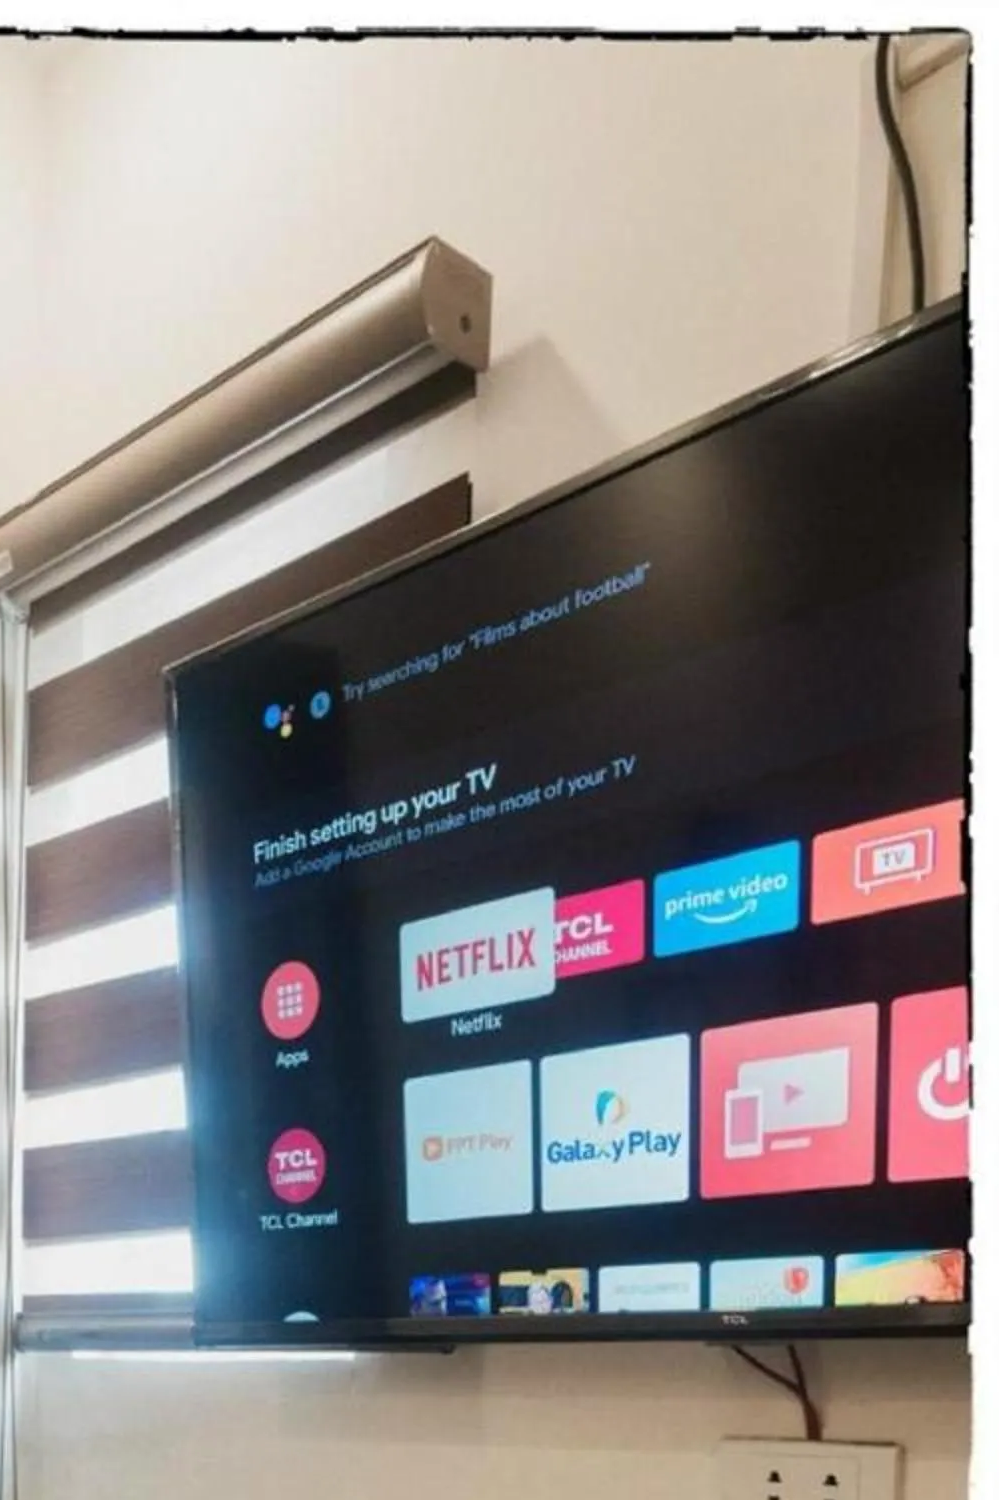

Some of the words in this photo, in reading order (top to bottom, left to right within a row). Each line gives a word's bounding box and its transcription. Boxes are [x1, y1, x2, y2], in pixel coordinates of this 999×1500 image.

[343, 682, 365, 701] Try
[367, 651, 439, 693] searching
[442, 640, 465, 662] for
[519, 597, 570, 630] about
[253, 829, 307, 864] Finish
[310, 809, 377, 846] setting
[380, 800, 408, 826] up
[411, 780, 462, 819] your
[465, 763, 497, 795] TV
[255, 869, 280, 888] Add
[282, 867, 292, 880] a
[294, 850, 342, 876] Google
[345, 831, 403, 860] Account
[406, 826, 422, 842] to
[424, 811, 466, 837] make
[469, 802, 497, 823] the
[500, 785, 542, 813] most
[543, 777, 565, 800] of
[567, 767, 609, 796] your
[612, 755, 637, 779] TV
[664, 886, 724, 920] prime
[728, 872, 788, 900] video
[555, 912, 614, 944] TCL
[416, 928, 536, 992] NETFLIX
[451, 1010, 503, 1037] Netflix
[275, 1049, 309, 1069] Apps
[274, 1148, 318, 1171] TCL
[547, 1136, 626, 1165] Galaxy
[628, 1129, 682, 1157] Play
[260, 1214, 284, 1231] TCL
[285, 1208, 338, 1229] Channel
[721, 1314, 749, 1325] TCL
